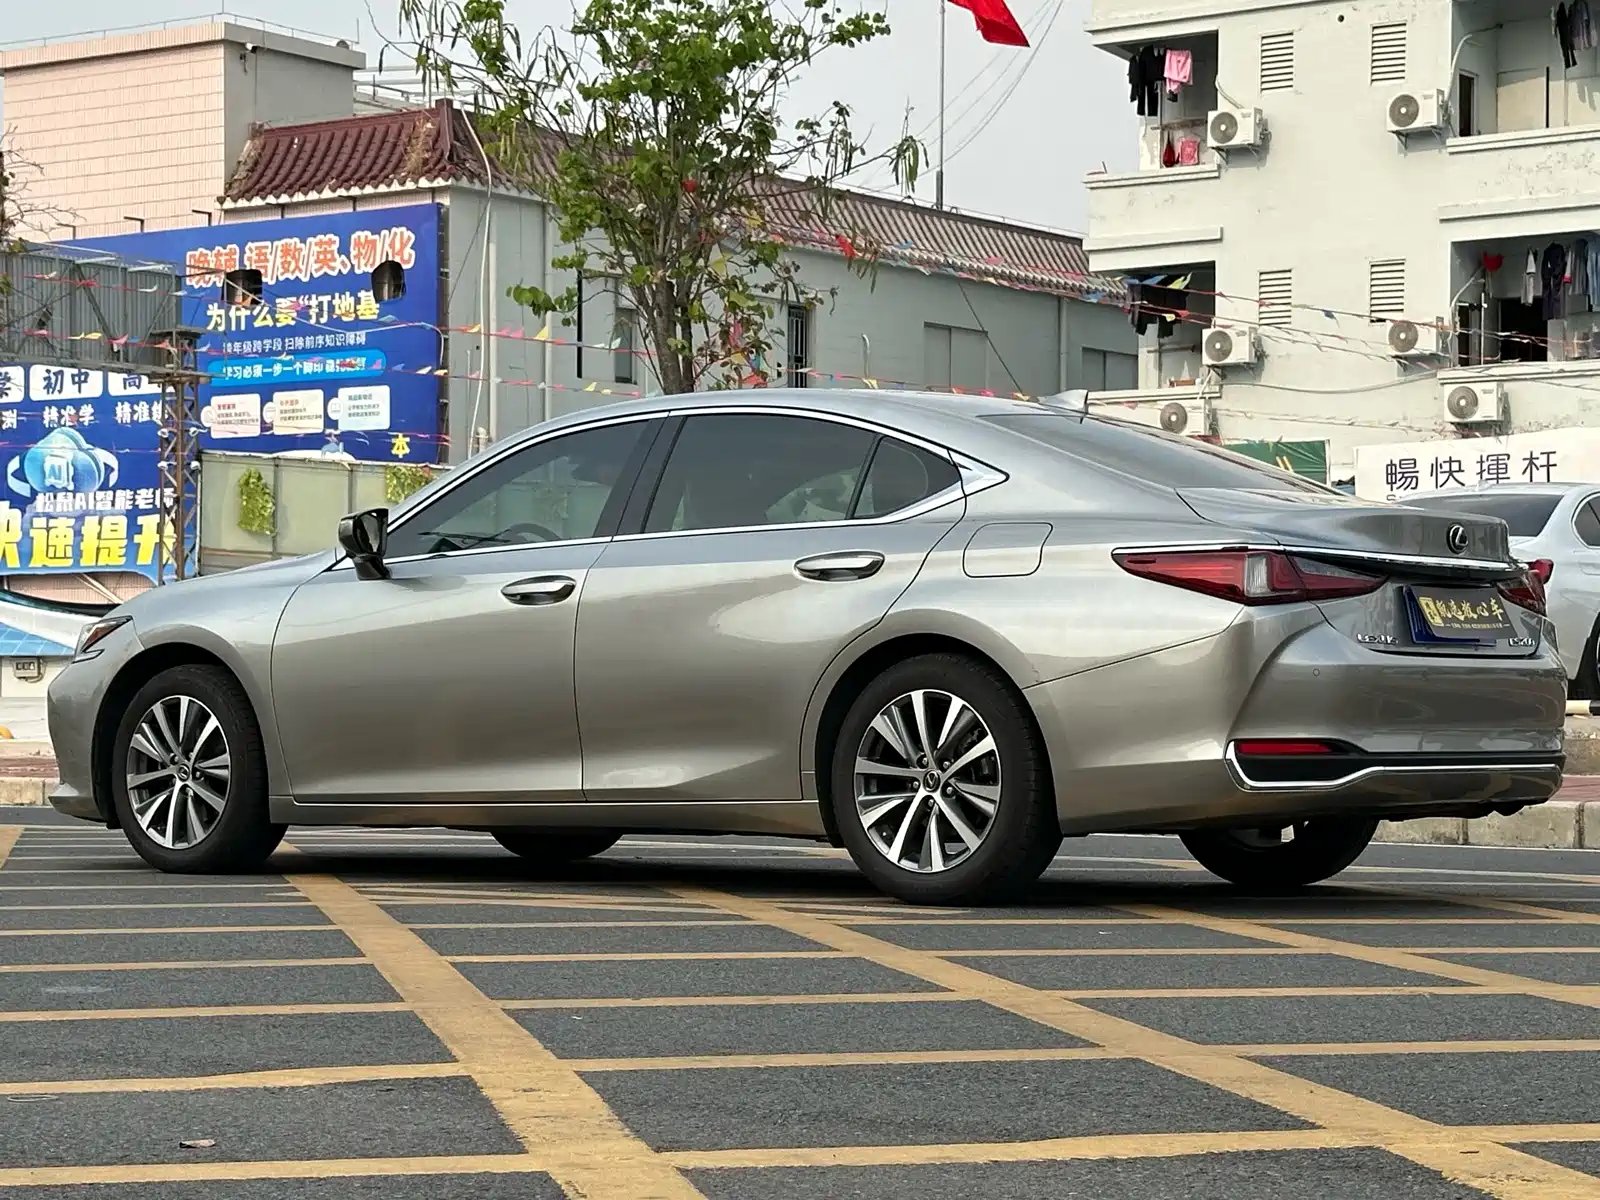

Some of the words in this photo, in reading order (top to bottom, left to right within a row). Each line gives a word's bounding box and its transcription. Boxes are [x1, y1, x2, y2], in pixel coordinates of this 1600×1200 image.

[43, 368, 90, 395] 初中
[43, 404, 94, 428] 精准学
[391, 433, 410, 458] 本
[1386, 451, 1557, 492] 暢快揮杆
